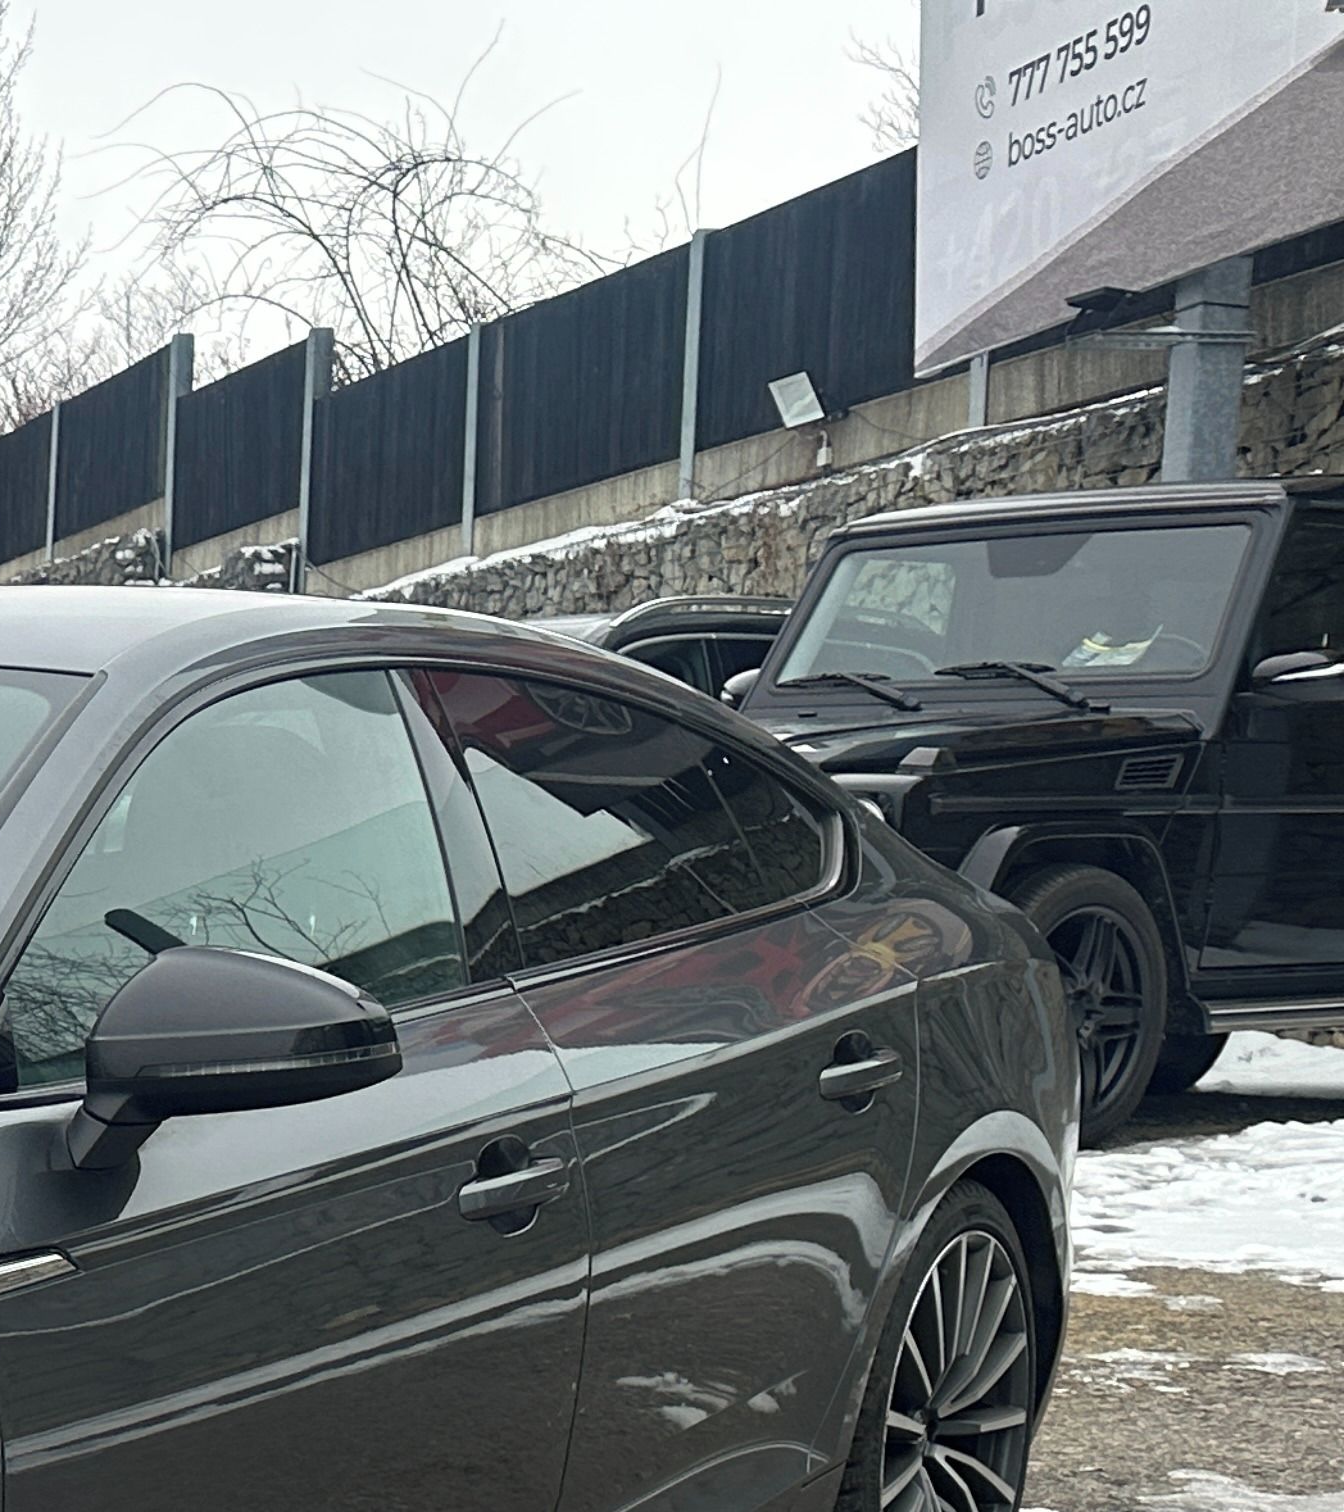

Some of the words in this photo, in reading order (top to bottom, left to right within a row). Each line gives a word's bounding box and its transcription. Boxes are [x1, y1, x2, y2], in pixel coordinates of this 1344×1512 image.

[1008, 52, 1051, 107] 777
[1057, 29, 1098, 84] 755
[1104, 4, 1151, 60] 599
[1008, 78, 1148, 167] boss-auto.cz
